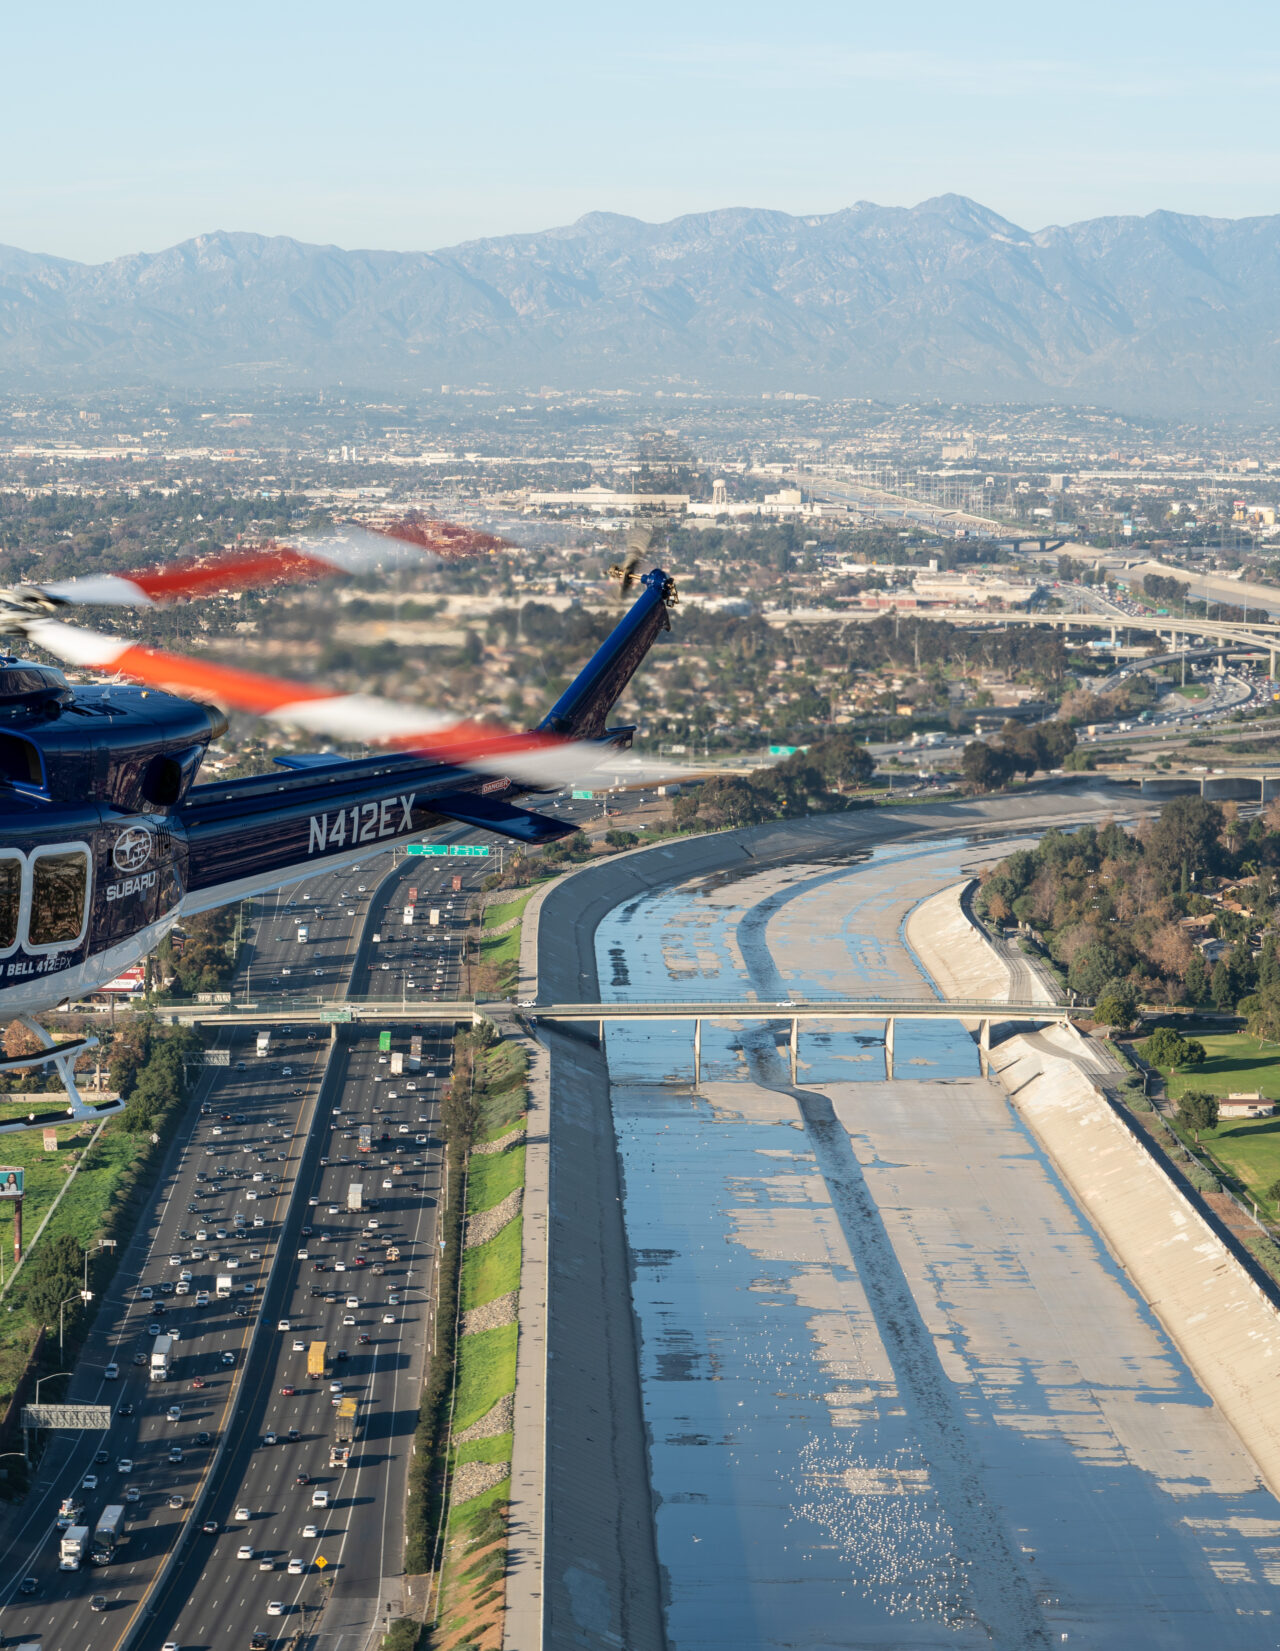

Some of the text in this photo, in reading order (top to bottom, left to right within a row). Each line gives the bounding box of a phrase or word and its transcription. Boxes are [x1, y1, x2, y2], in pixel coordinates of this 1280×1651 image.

[483, 779, 508, 791] DANGER
[308, 793, 415, 854] N412EX
[106, 871, 156, 901] SUBARU
[7, 962, 35, 976] BELL
